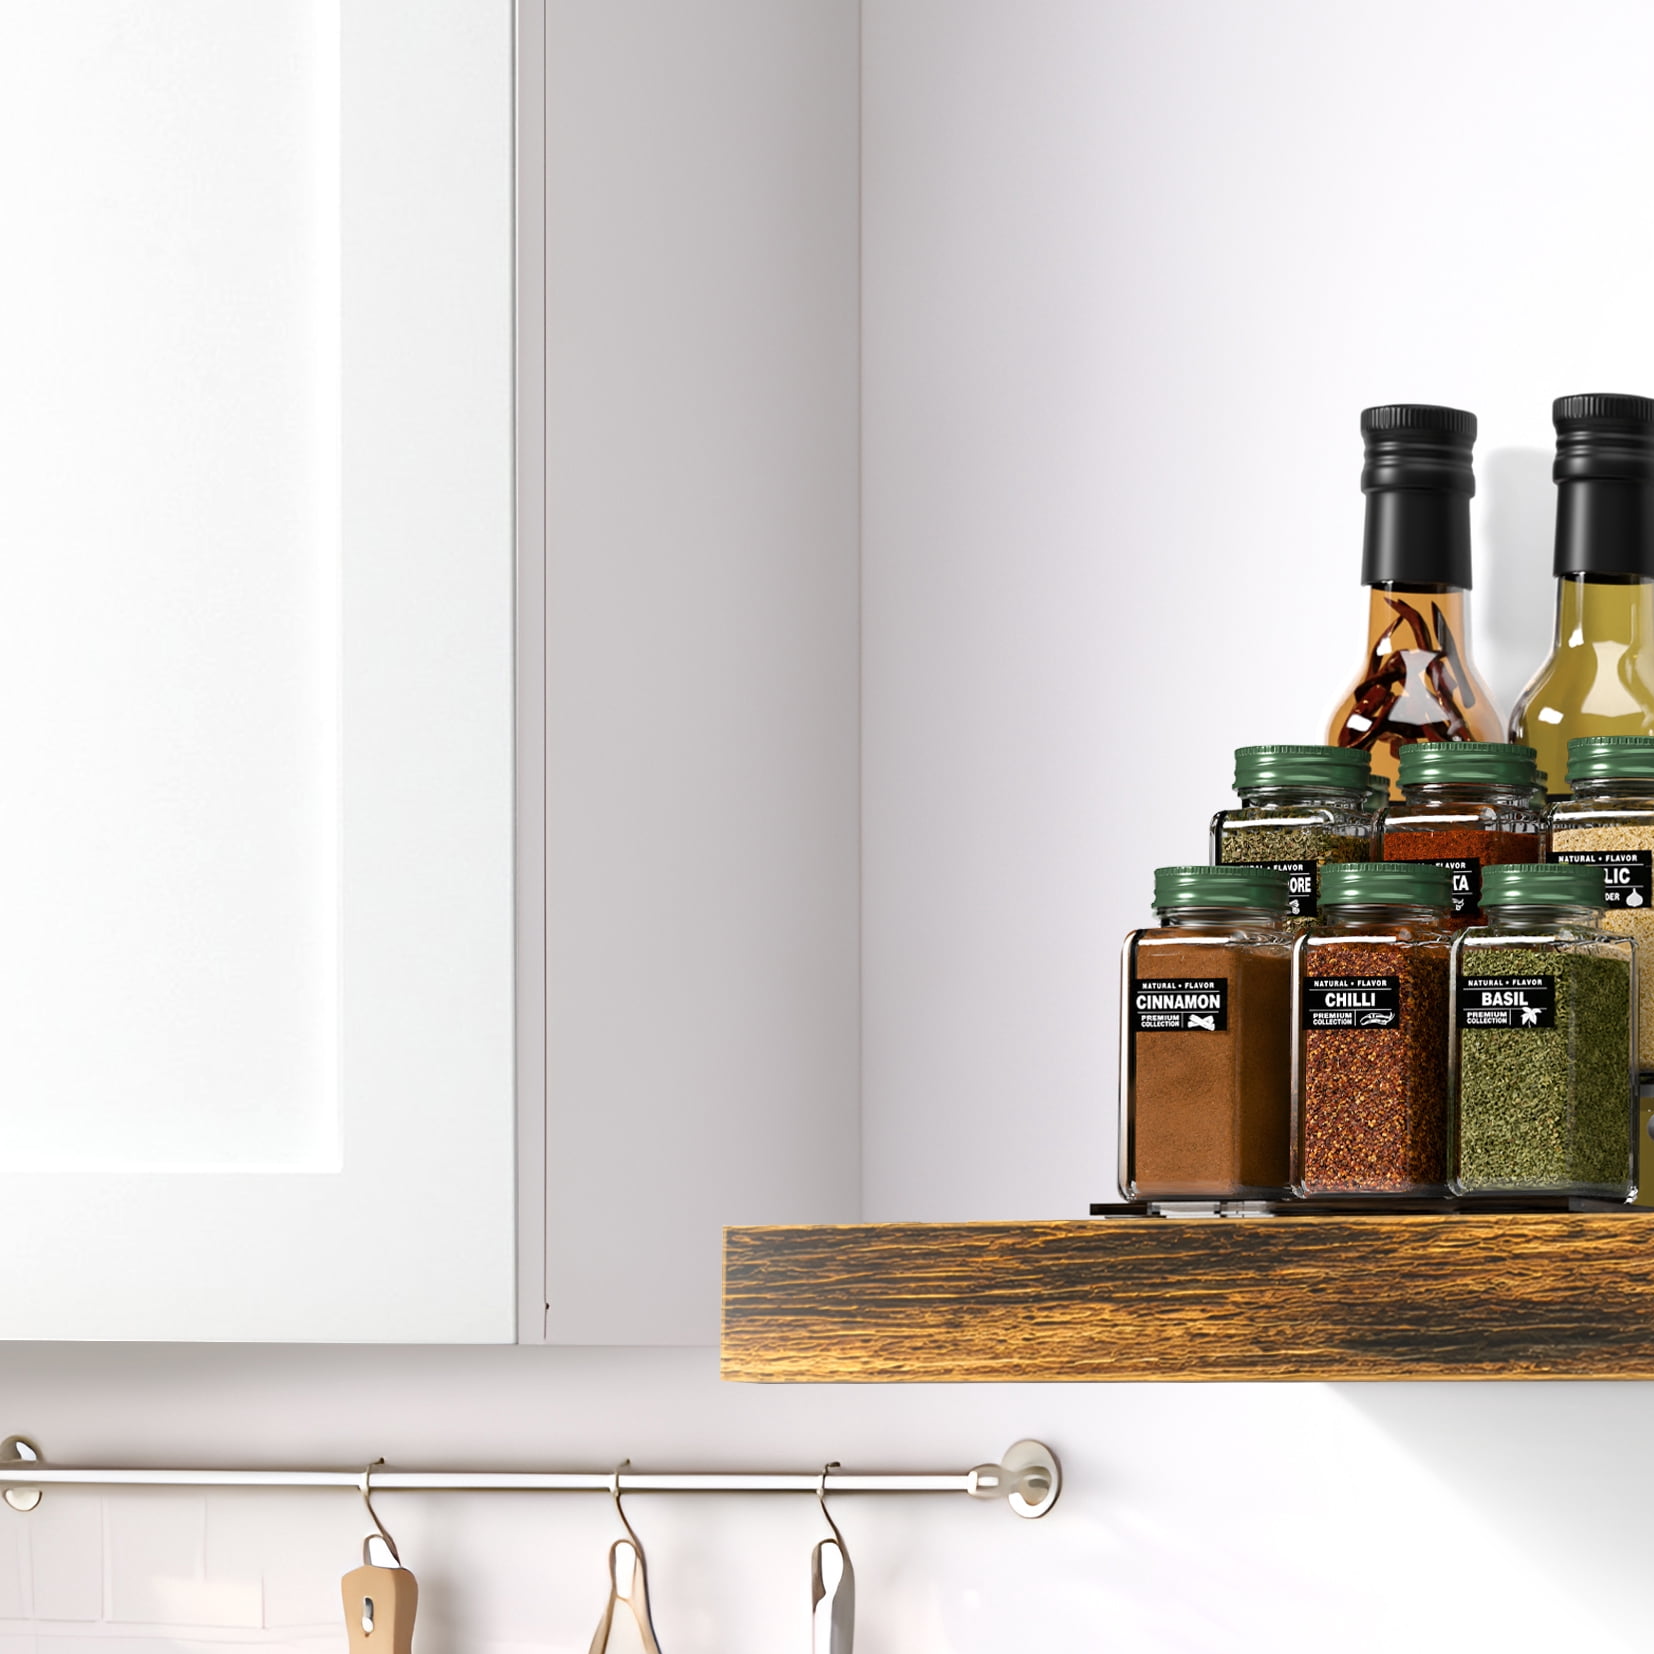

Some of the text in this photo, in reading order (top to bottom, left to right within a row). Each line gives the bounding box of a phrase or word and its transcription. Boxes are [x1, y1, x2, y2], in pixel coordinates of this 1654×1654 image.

[1558, 854, 1638, 863] NATURAL FLAVOR
[1288, 876, 1312, 893] ORE
[1184, 981, 1215, 989] FLAVOR
[1135, 994, 1221, 1010] CINNAMON
[1324, 992, 1376, 1008] CHILLI
[1481, 991, 1529, 1006] BASIL
